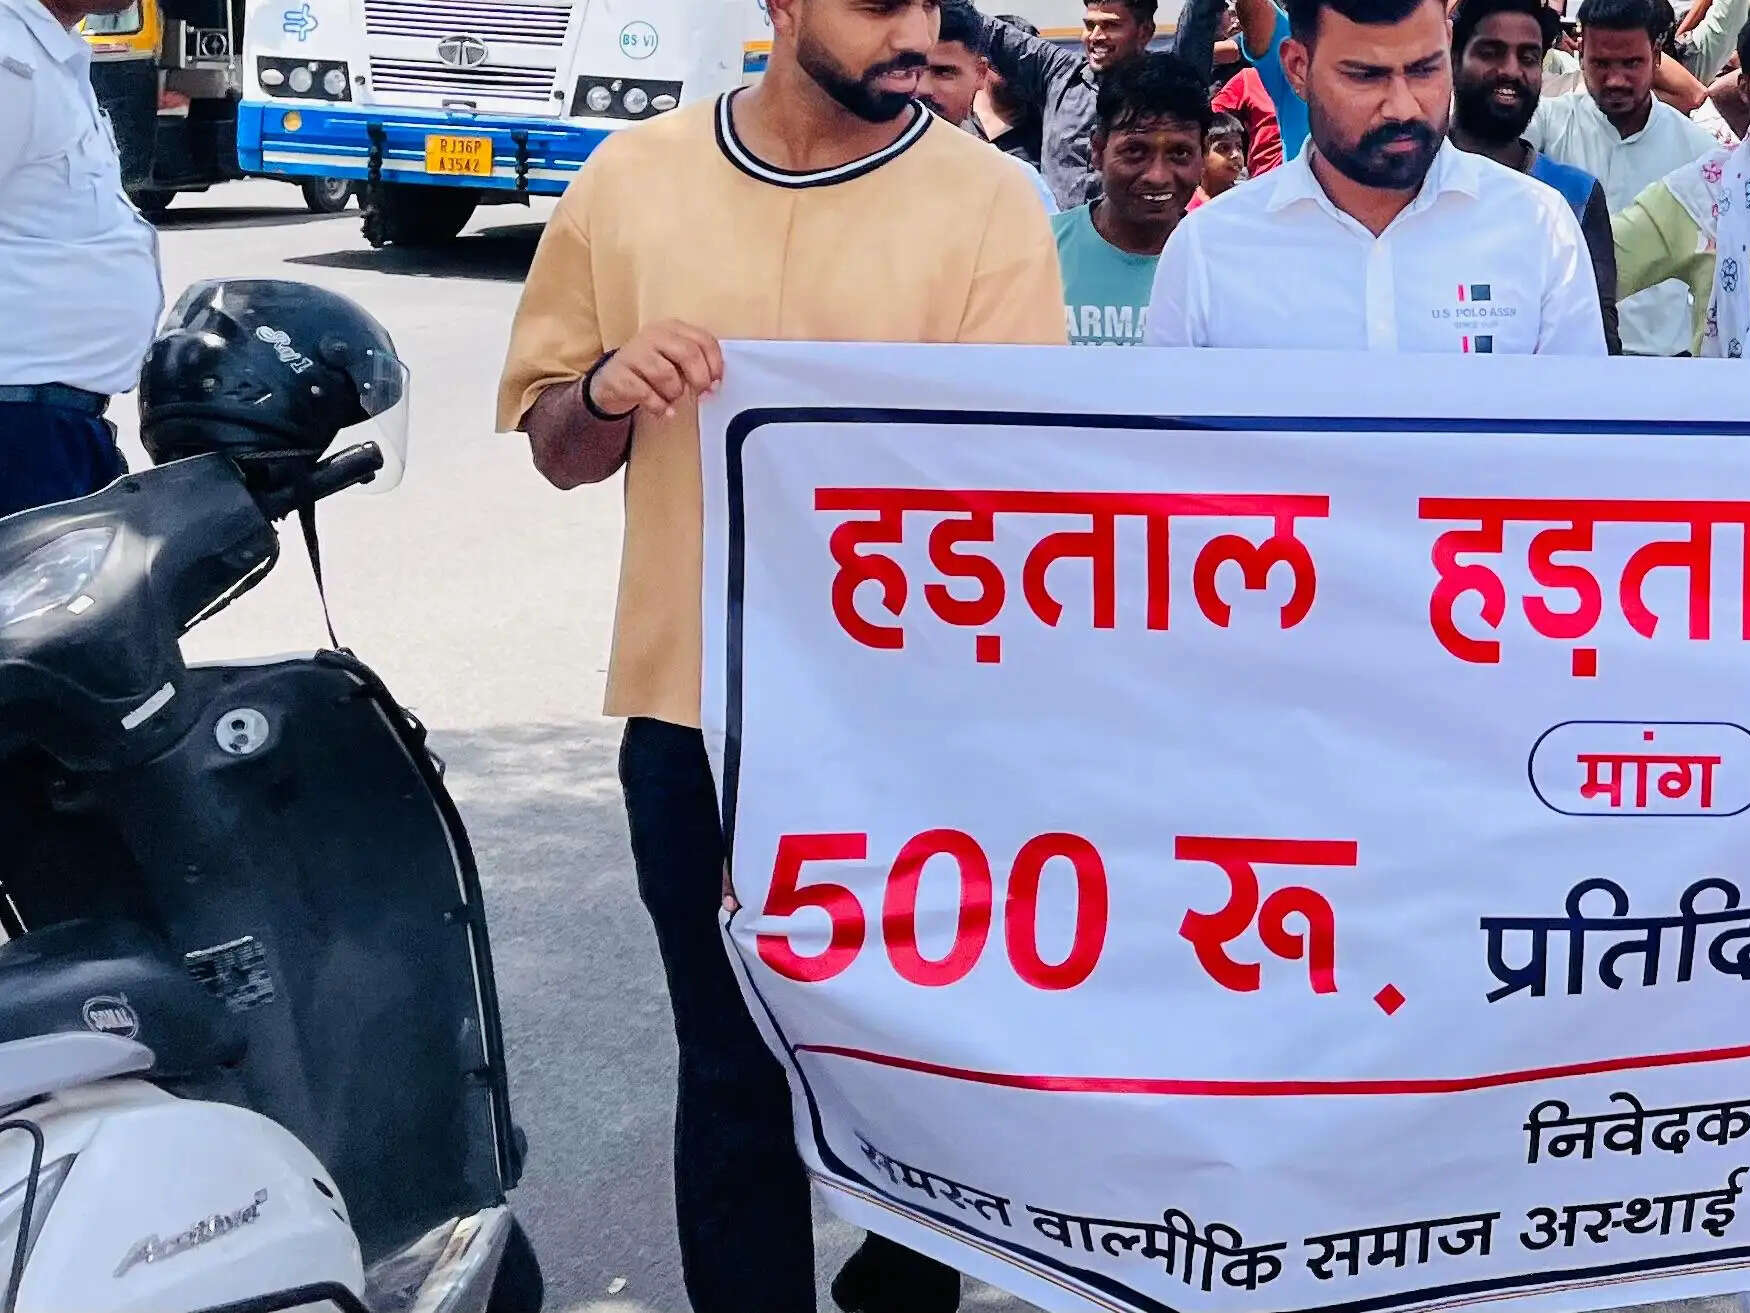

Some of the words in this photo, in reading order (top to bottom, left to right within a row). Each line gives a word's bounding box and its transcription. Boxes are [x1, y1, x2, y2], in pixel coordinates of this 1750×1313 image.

[814, 488, 1330, 664] हड़ताल
[1577, 731, 1722, 808] मांग
[756, 829, 1109, 990] 500
[1024, 1206, 1287, 1292] वाल्मीकि
[1305, 1211, 1502, 1281] समाज
[1520, 1166, 1750, 1253] अस्थाई
